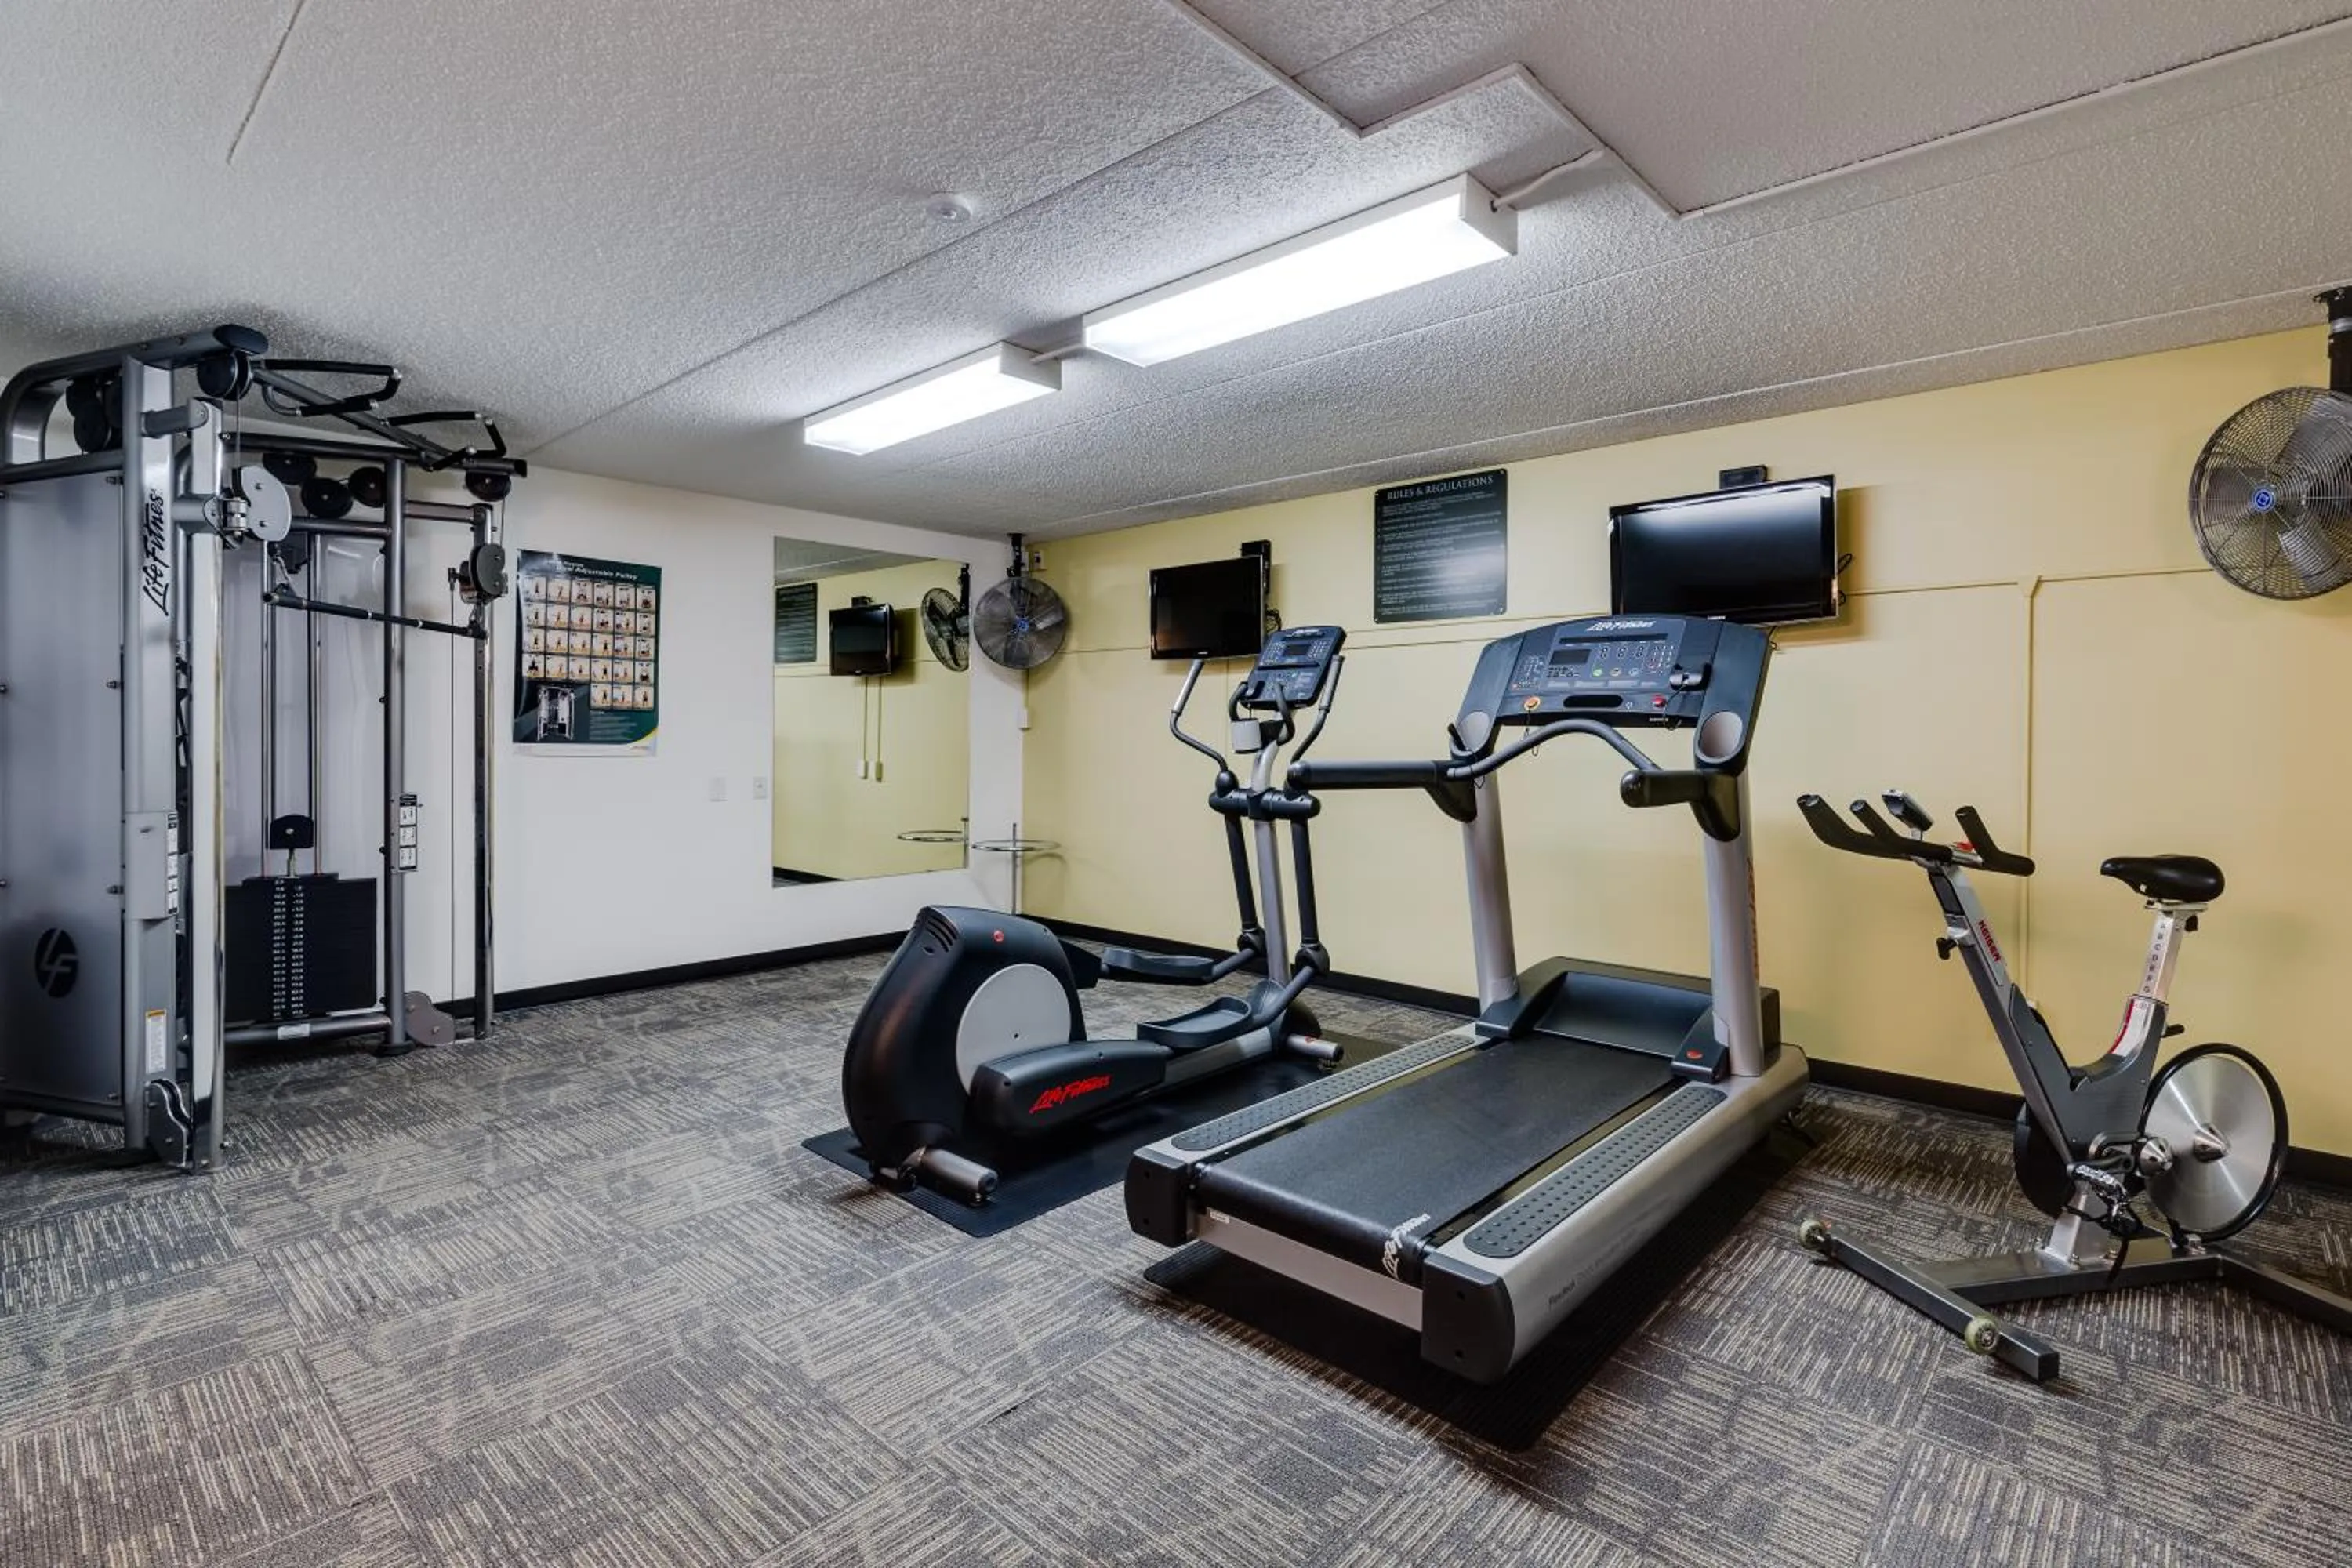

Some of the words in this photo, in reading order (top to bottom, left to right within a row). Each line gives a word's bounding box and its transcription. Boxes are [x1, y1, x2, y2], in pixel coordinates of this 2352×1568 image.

[1387, 488, 1414, 500] RULES
[1425, 475, 1494, 494] REGULATIONS
[143, 488, 170, 568] Fitnes
[143, 564, 170, 616] Life
